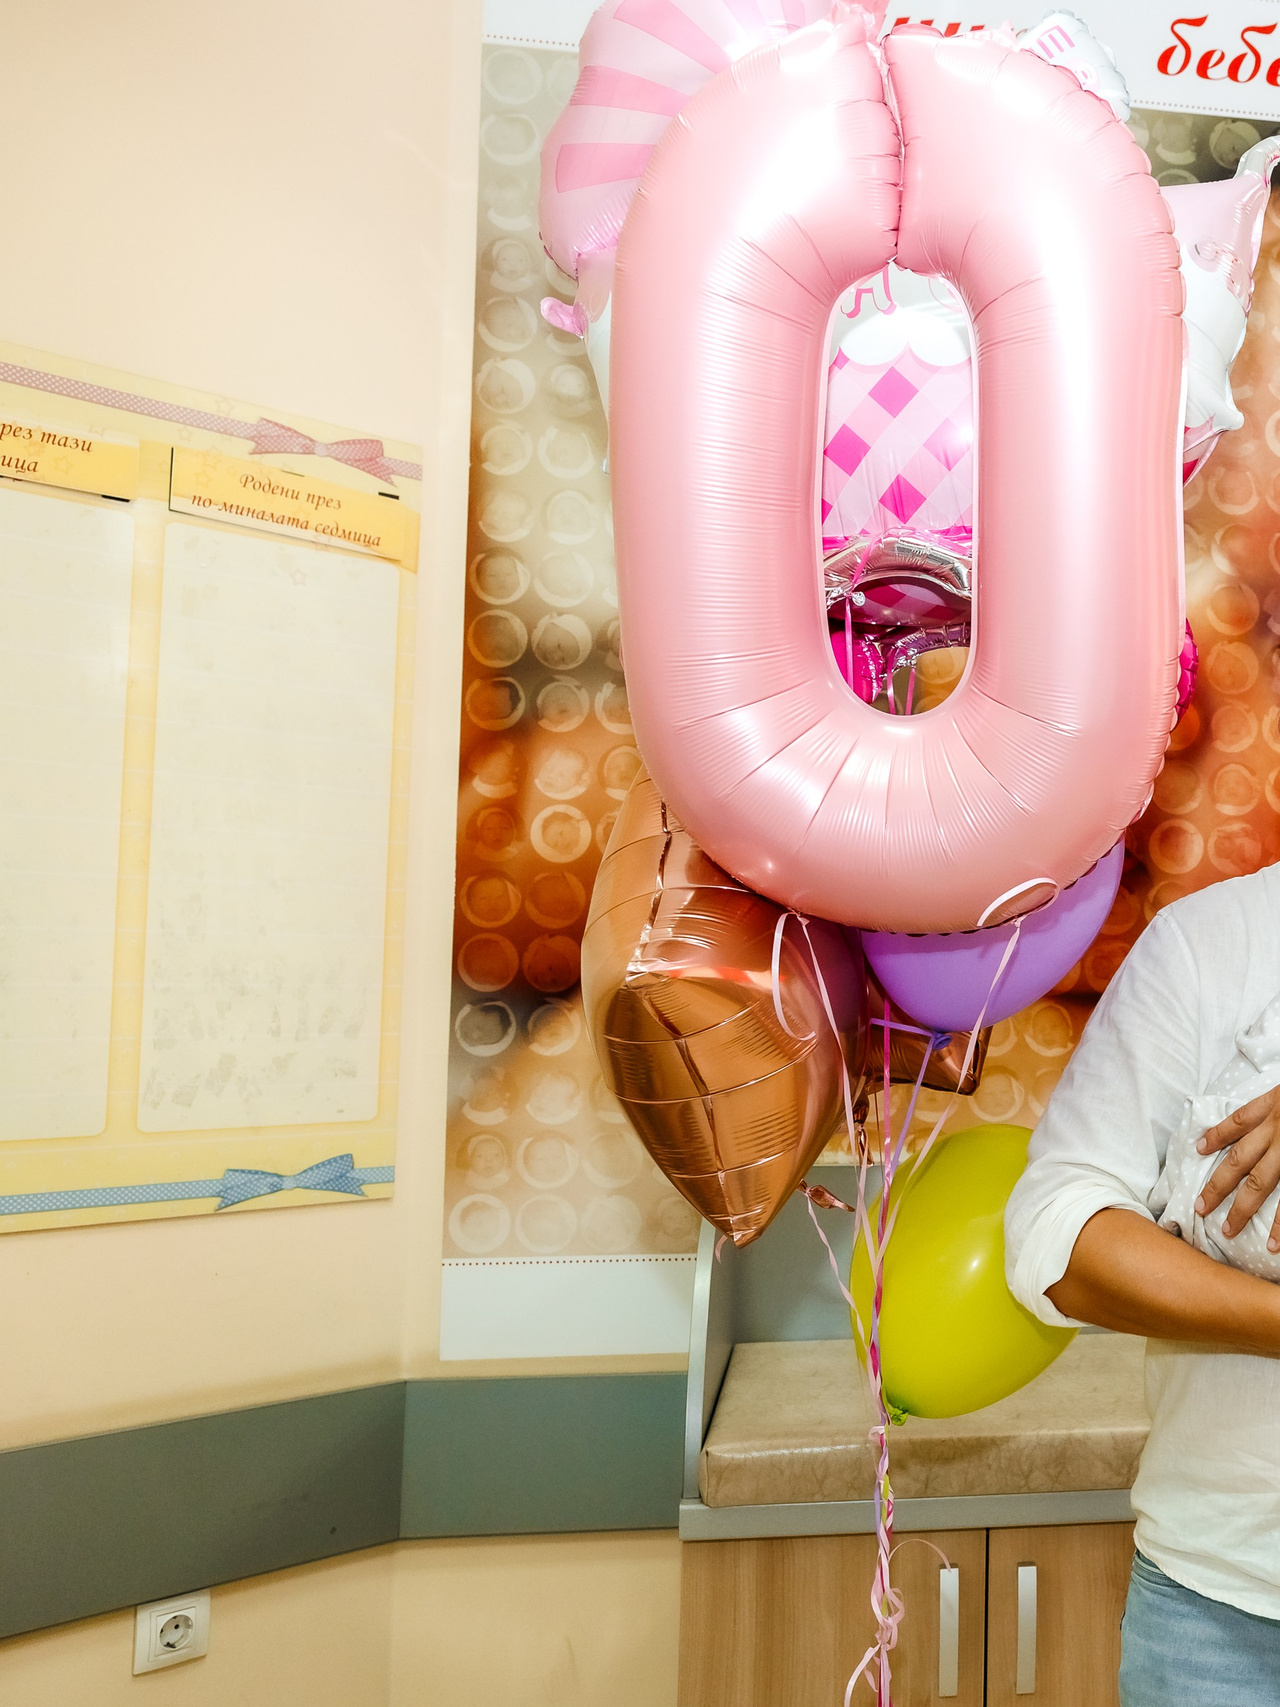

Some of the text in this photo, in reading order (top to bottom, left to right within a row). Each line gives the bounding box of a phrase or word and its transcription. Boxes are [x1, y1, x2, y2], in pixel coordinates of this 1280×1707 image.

[40, 431, 93, 452] тази
[239, 474, 342, 510] Родени през
[191, 494, 381, 547] по-миналата седмица
